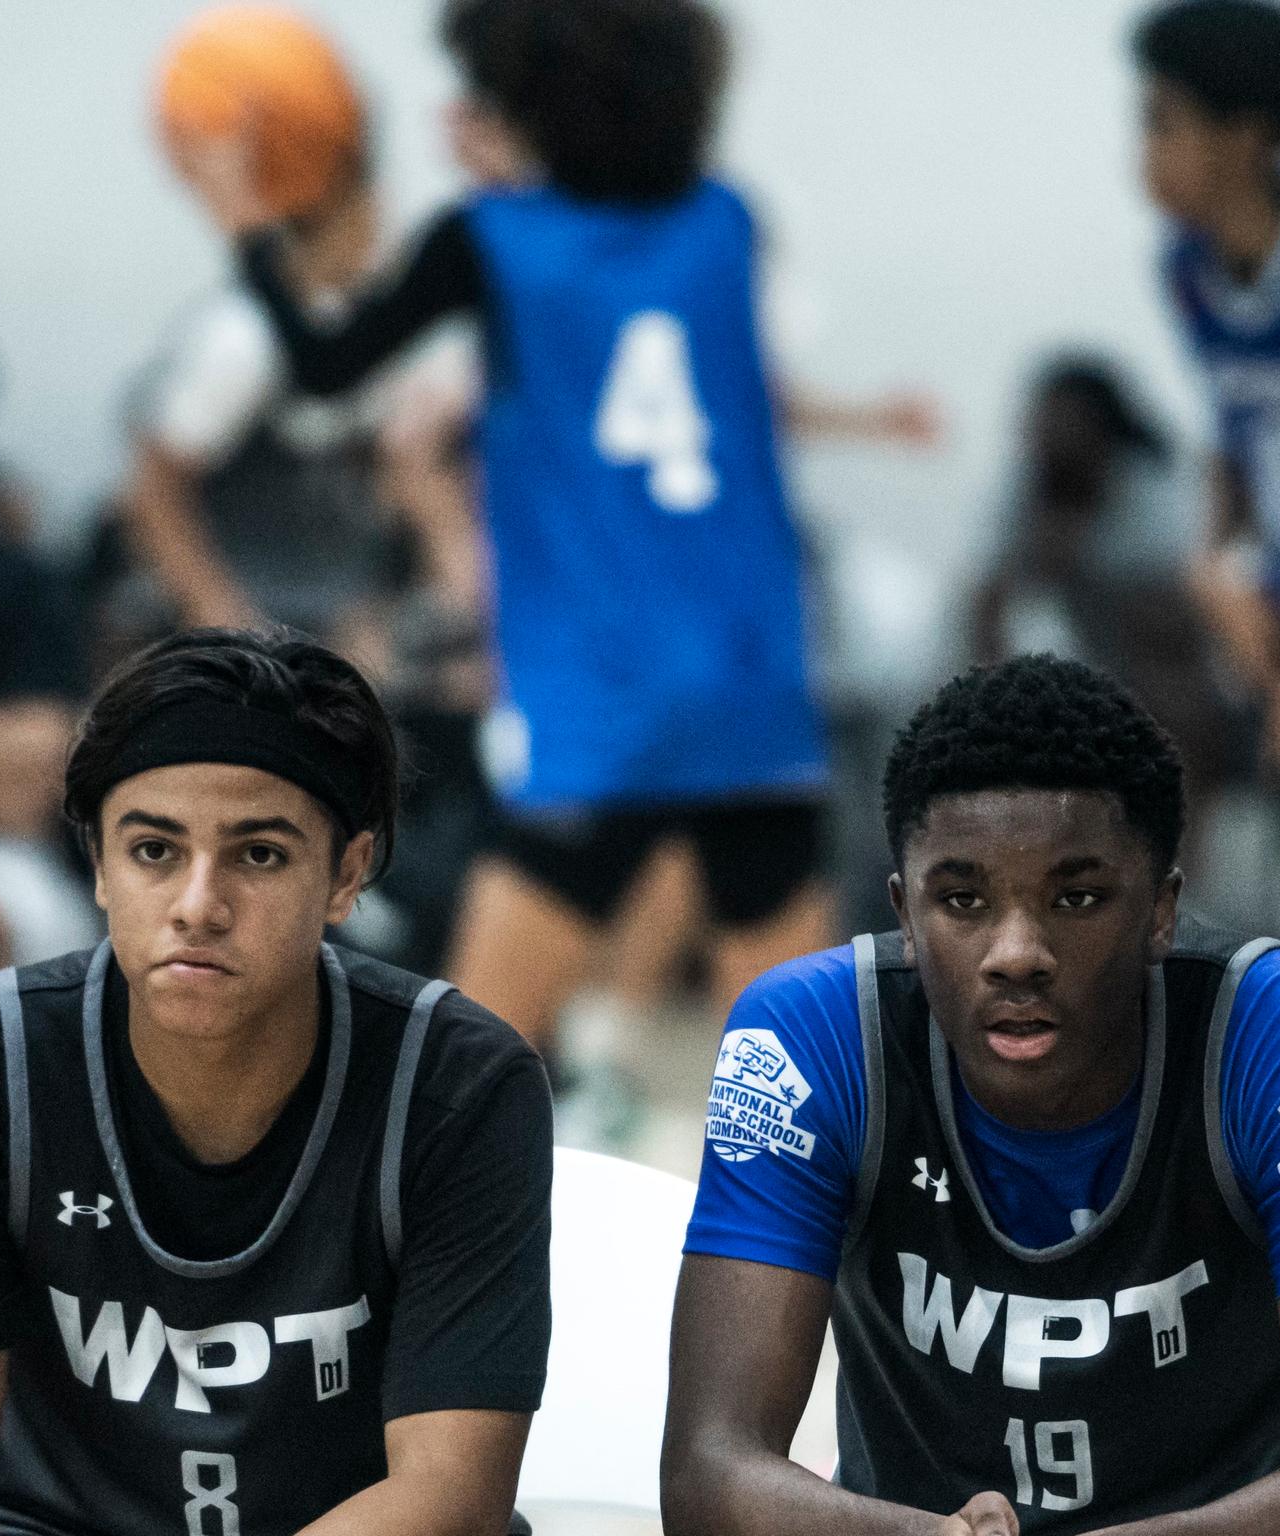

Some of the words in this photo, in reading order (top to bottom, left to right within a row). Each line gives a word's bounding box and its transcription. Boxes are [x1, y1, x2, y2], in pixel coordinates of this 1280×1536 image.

[592, 308, 720, 514] 4
[712, 1082, 784, 1123] NATIONAL
[735, 1109, 807, 1152] SCHOOL
[48, 1285, 372, 1414] WPT
[897, 1258, 1210, 1391] WPT
[1156, 1325, 1180, 1362] D1
[319, 1357, 343, 1394] D1
[1003, 1417, 1094, 1512] 19
